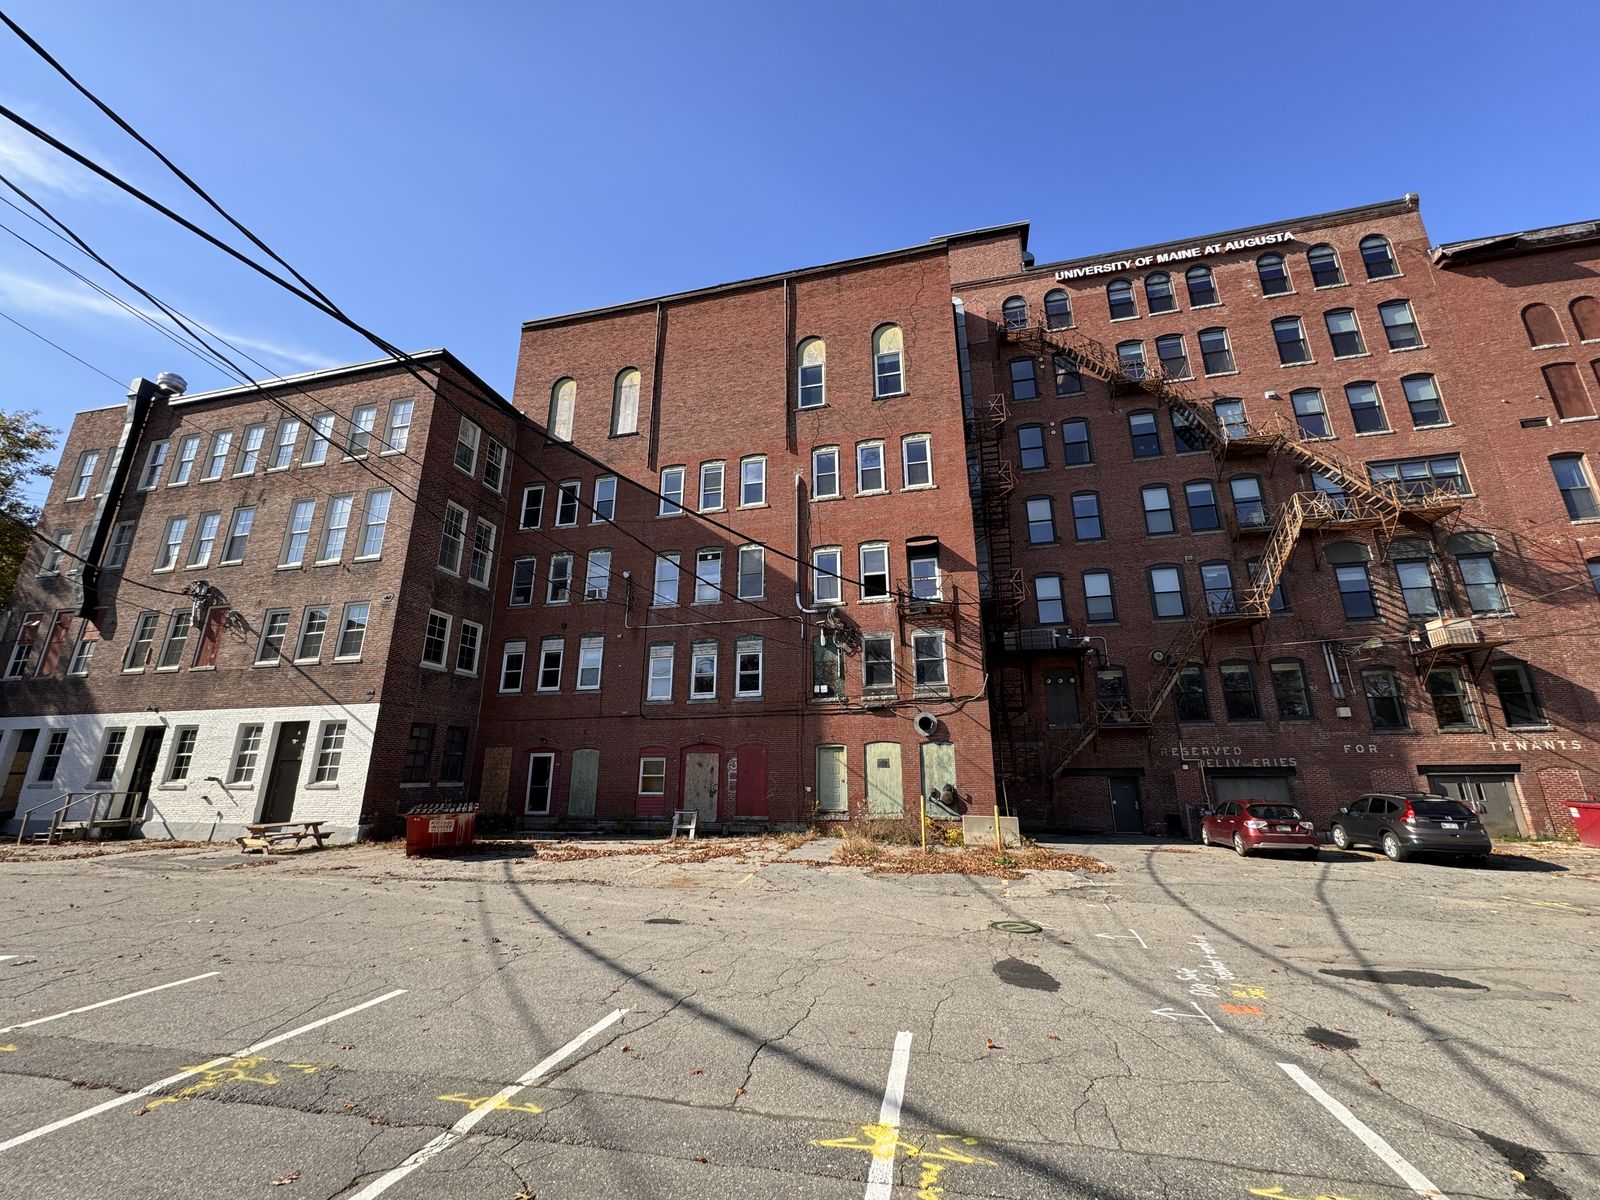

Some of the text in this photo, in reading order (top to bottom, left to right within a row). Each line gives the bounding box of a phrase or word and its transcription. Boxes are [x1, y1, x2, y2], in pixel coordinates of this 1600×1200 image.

[1055, 231, 1296, 280] UNIVERSITY OF MAINE AT AUGUSTA
[1160, 740, 1582, 756] RESERVED FOR TENANTS
